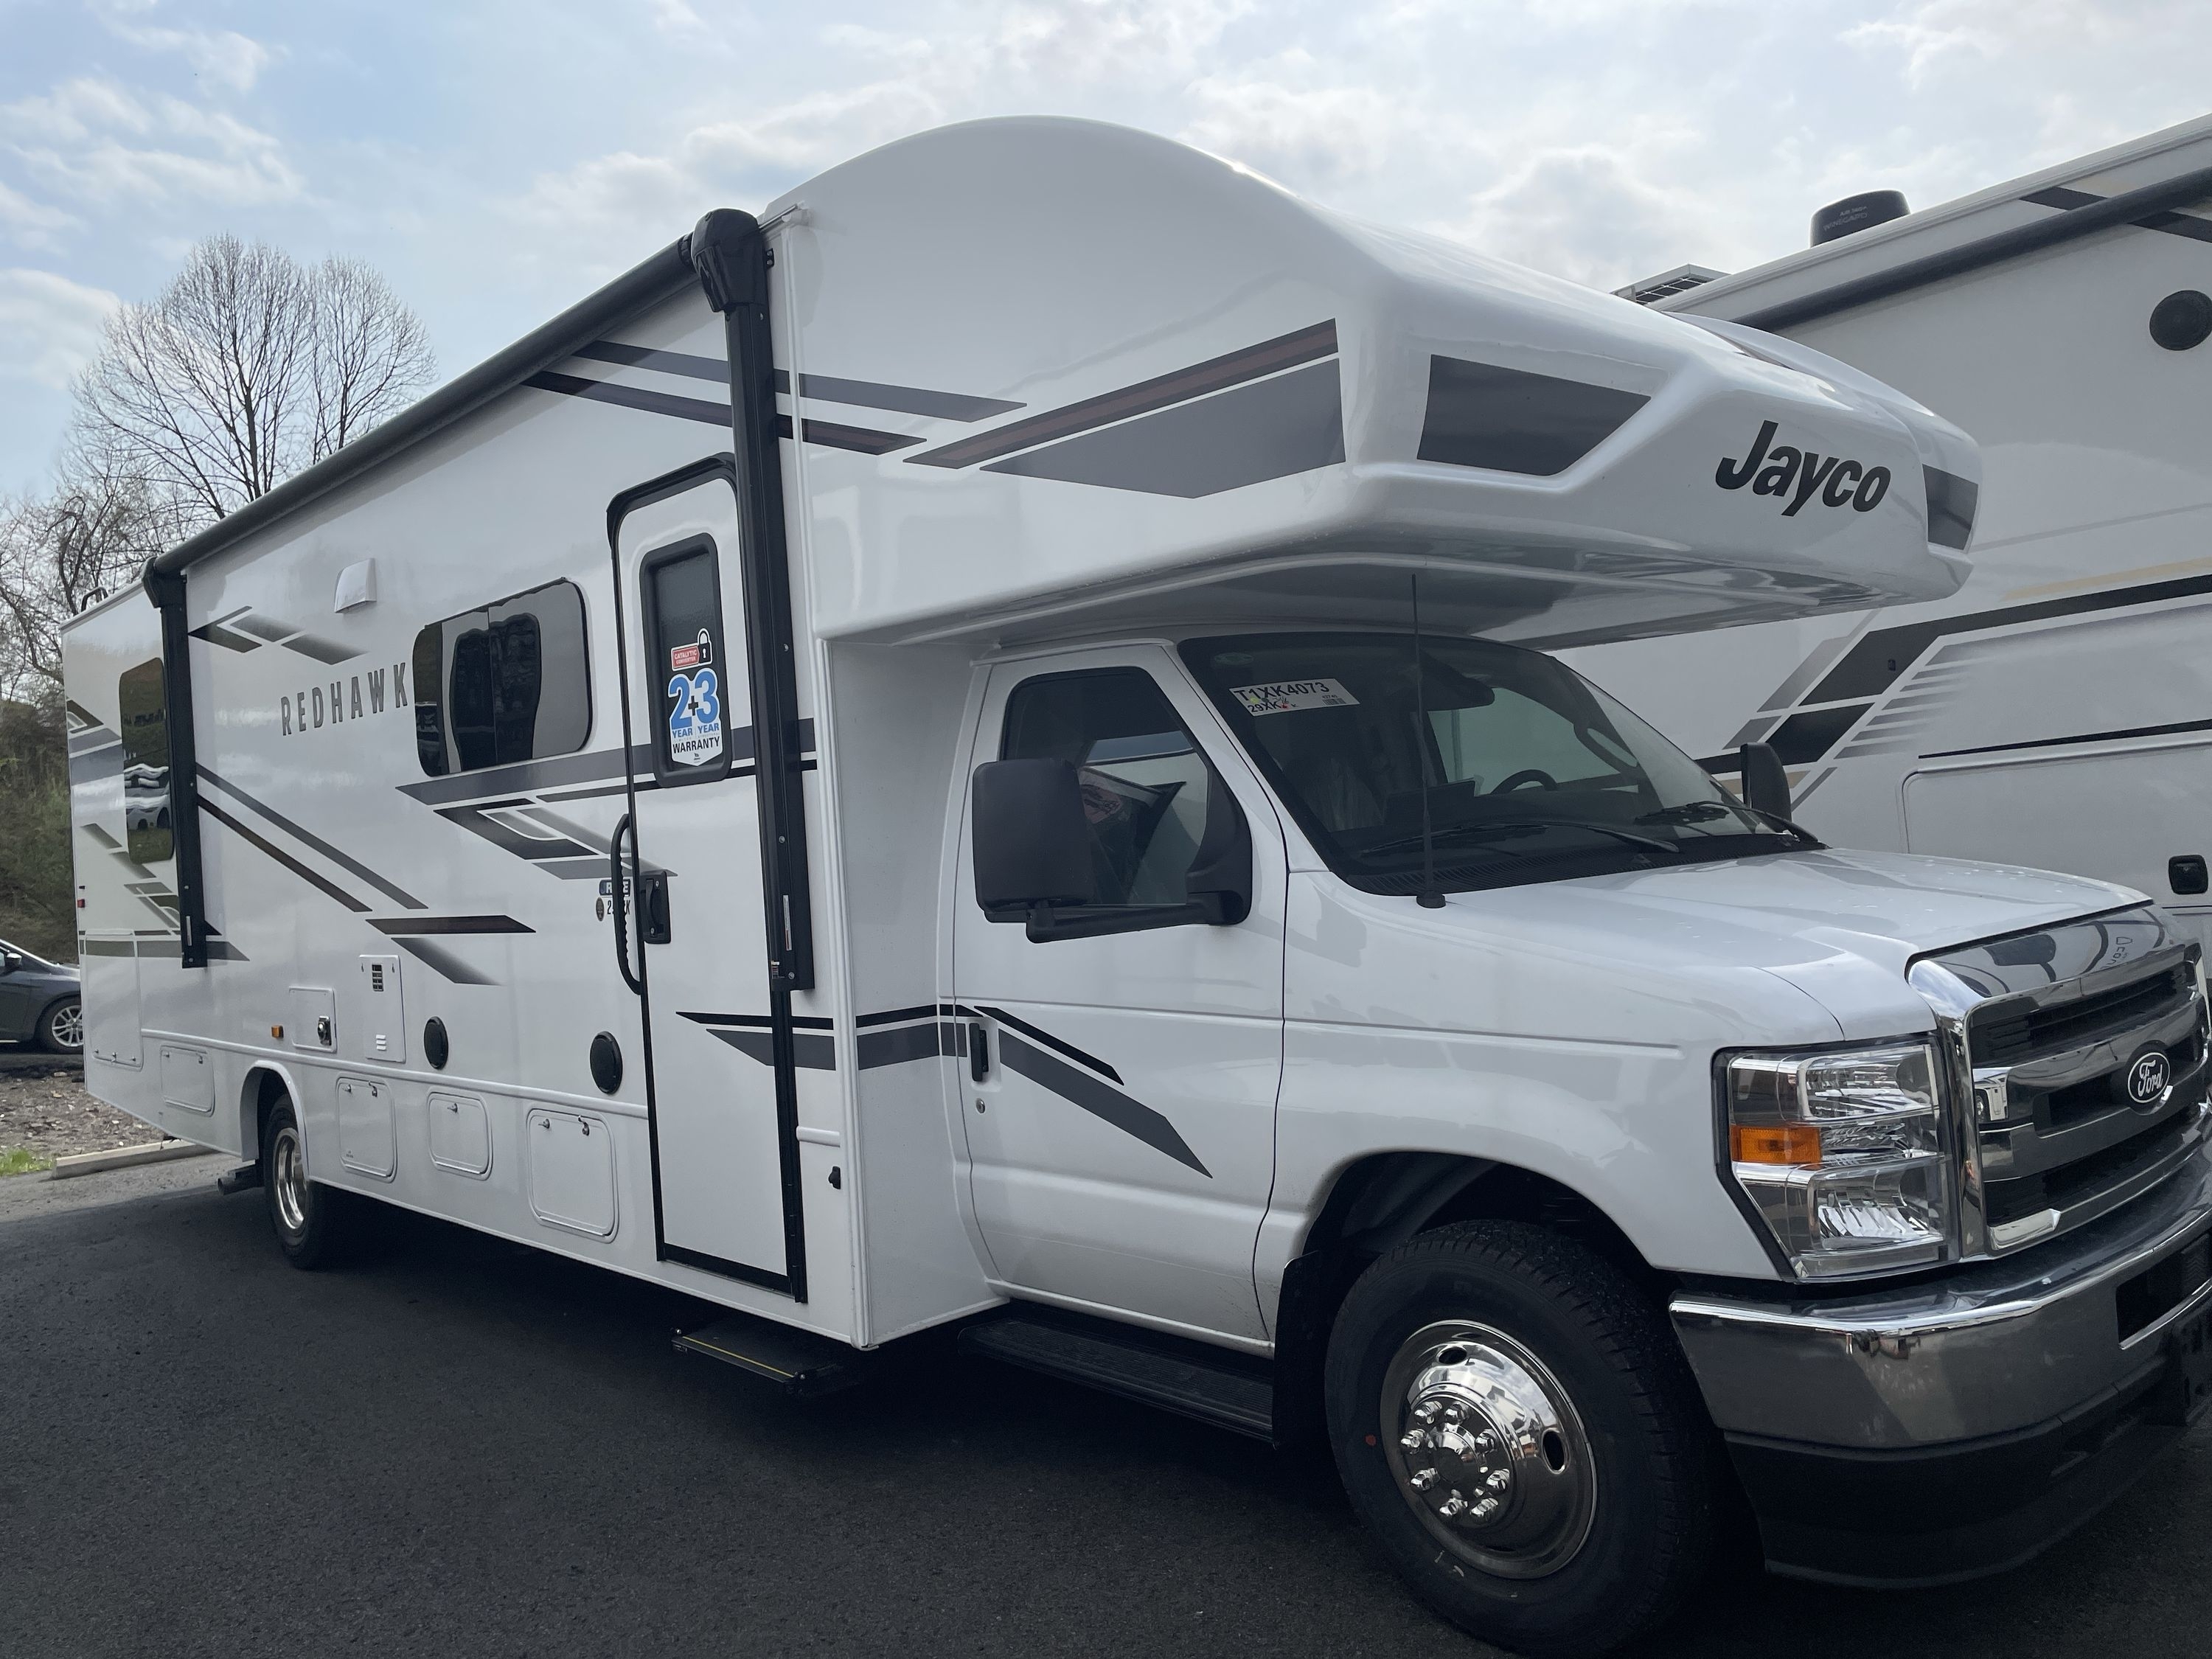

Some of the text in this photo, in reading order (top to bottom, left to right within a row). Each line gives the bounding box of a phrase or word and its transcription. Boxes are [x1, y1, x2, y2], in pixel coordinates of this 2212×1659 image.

[1823, 212, 1869, 231] WINEGARD
[1715, 420, 1891, 517] Jayco
[674, 649, 698, 660] CATALYTIC
[280, 662, 408, 736] REDHAWK
[1233, 681, 1330, 701] T1XK4073
[672, 723, 720, 739] YEAR YEAR
[672, 736, 720, 754] WARRANTY
[2138, 1060, 2163, 1096] Ford
